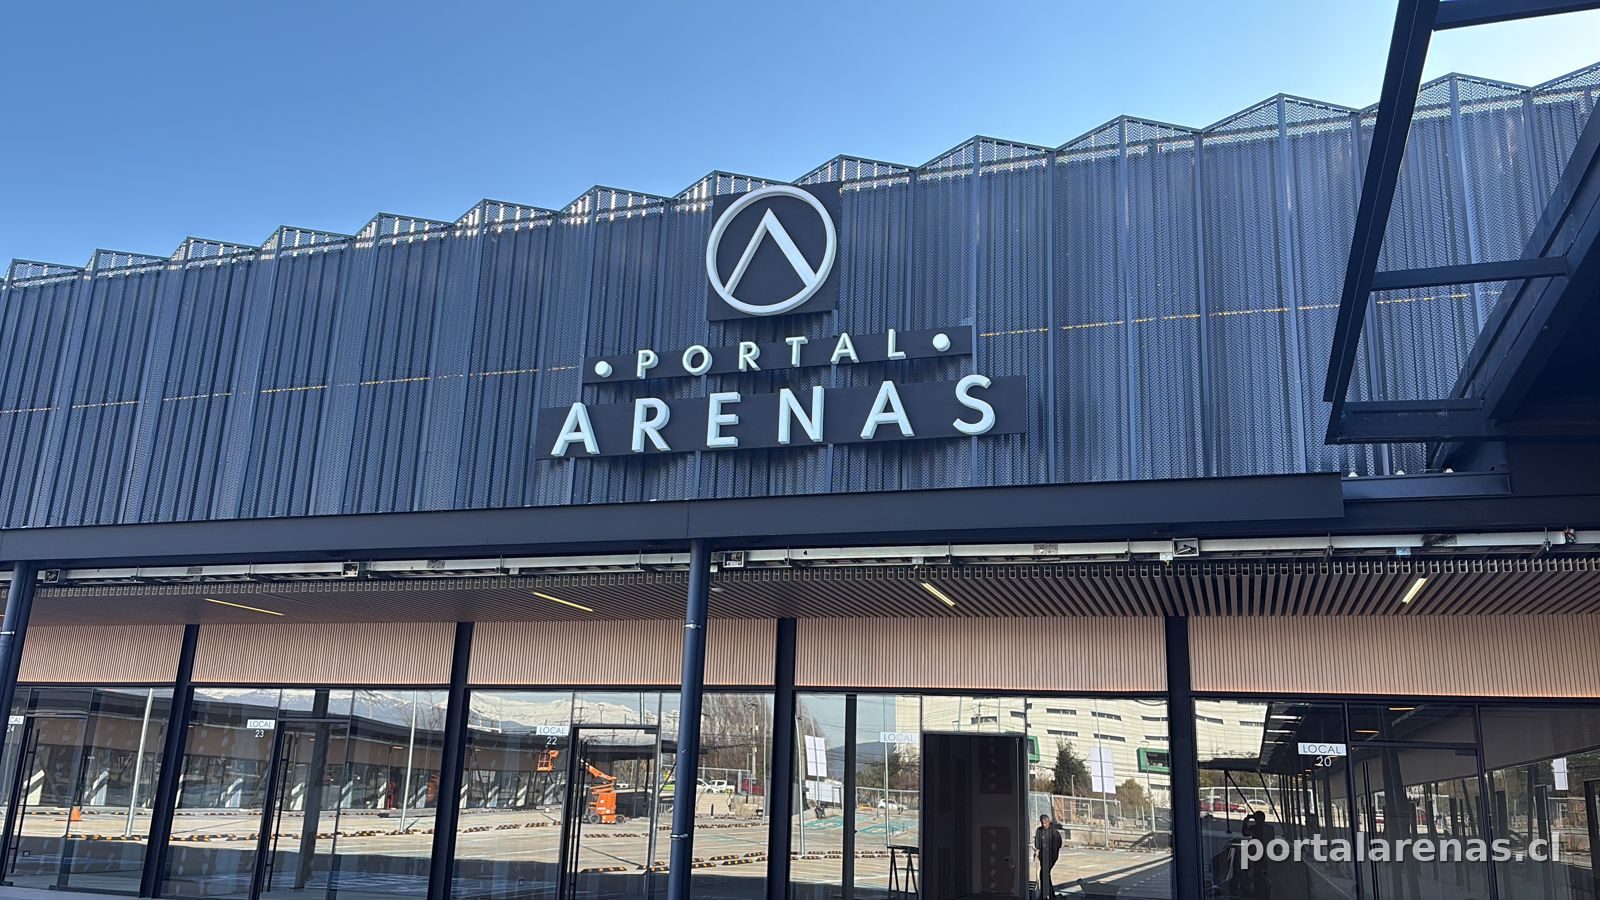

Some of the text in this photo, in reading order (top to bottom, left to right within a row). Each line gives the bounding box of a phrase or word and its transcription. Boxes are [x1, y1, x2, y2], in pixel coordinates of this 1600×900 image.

[636, 329, 906, 380] PORTAL
[551, 374, 996, 457] ARENAS
[249, 720, 272, 728] LOCAL
[255, 730, 265, 738] 23
[539, 726, 566, 735] LOCAL
[546, 736, 558, 745] 22
[883, 733, 914, 742] LOCAL
[1302, 744, 1342, 754] LOCAL
[1315, 756, 1332, 767] 20
